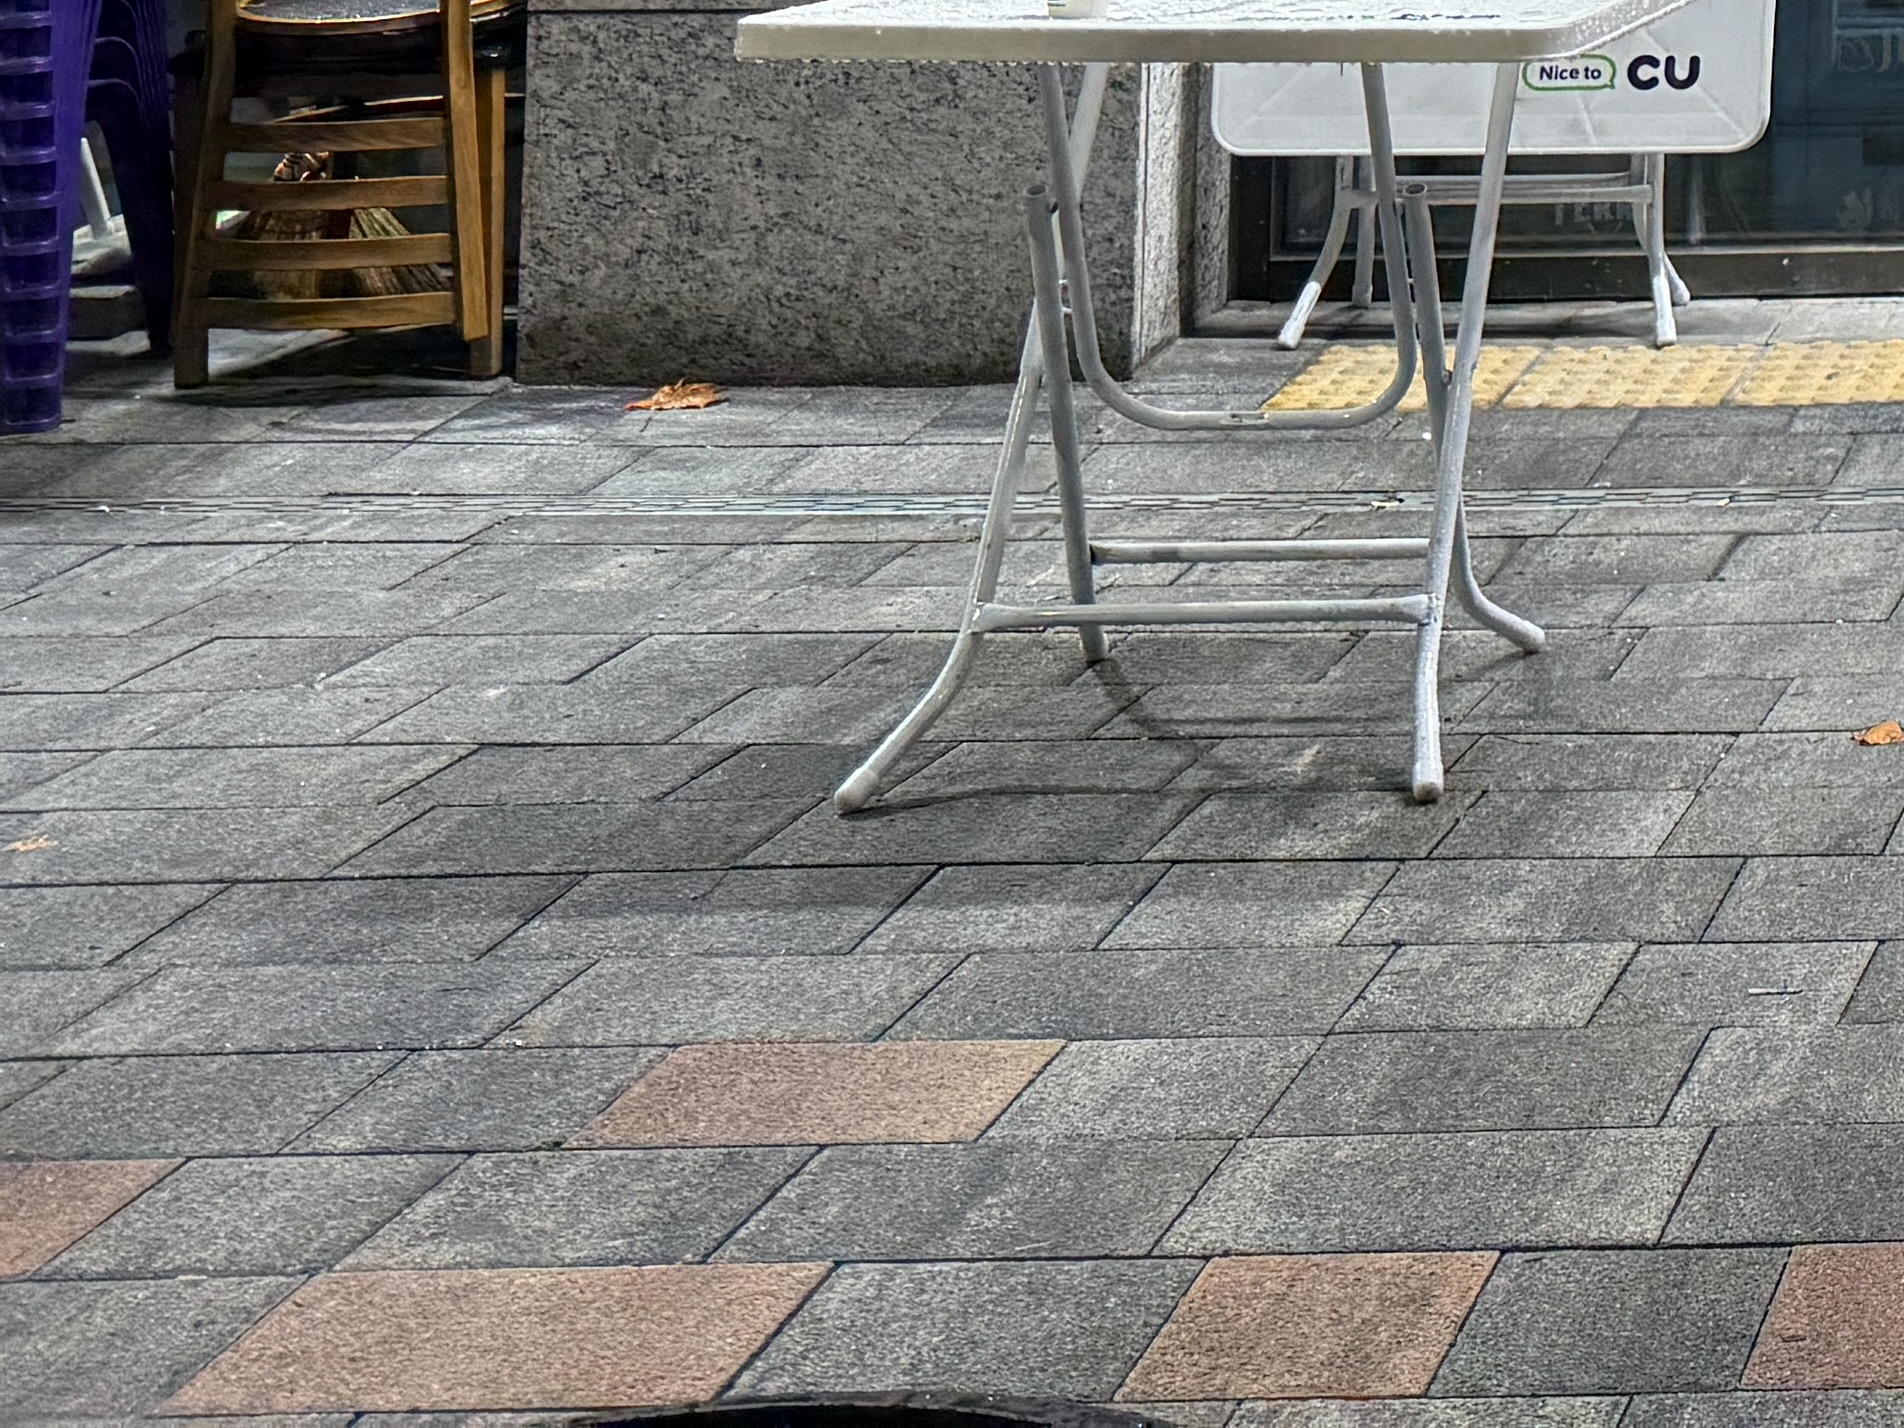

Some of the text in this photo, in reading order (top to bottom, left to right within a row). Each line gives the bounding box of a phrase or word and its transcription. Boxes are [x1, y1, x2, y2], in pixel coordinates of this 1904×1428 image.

[1539, 55, 1700, 90] Nice to CU
